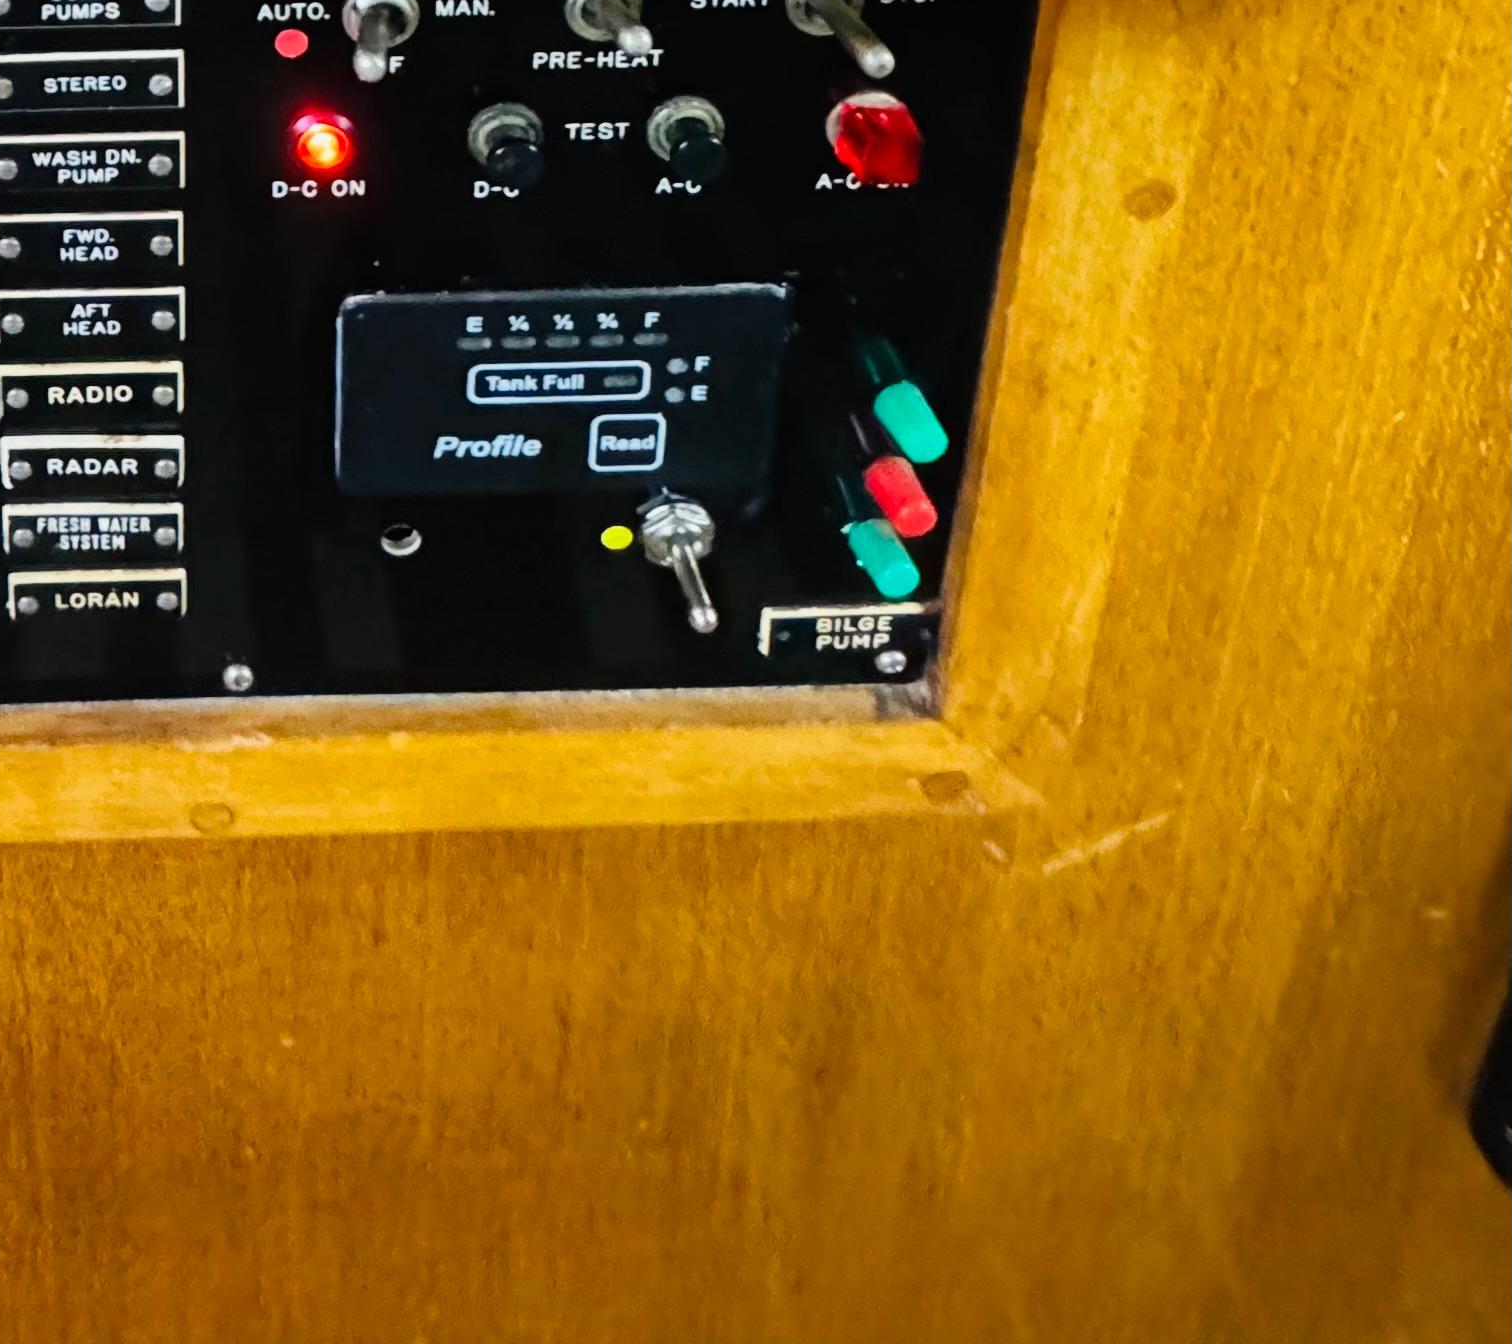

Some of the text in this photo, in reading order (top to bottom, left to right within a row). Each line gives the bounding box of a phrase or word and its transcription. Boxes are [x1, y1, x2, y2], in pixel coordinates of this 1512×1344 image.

[41, 2, 121, 22] PUMPS
[256, 2, 331, 22] AUTO.
[434, 0, 496, 17] MAN.
[43, 75, 127, 94] STEREO
[564, 121, 631, 141] TEST
[32, 149, 142, 168] WASH DN.
[57, 167, 119, 184] PUMP
[272, 179, 366, 198] D-C ON
[63, 228, 115, 245] FWD.
[60, 245, 119, 262] HEAD
[71, 303, 112, 319] AFT
[63, 320, 122, 336] HEAD
[466, 316, 484, 333] E
[644, 311, 661, 329] F
[694, 355, 711, 373] F
[484, 374, 585, 392] Tank Full
[47, 385, 134, 405] RADIO
[690, 384, 709, 402] E
[433, 434, 543, 460] Profile
[599, 435, 656, 452] Read
[46, 457, 139, 476] RADAR
[36, 516, 151, 534] FRESH WATER
[59, 533, 126, 551] SYSTEM
[54, 591, 140, 609] LORAN
[815, 616, 894, 634] BILGE
[815, 633, 890, 651] PUMP
